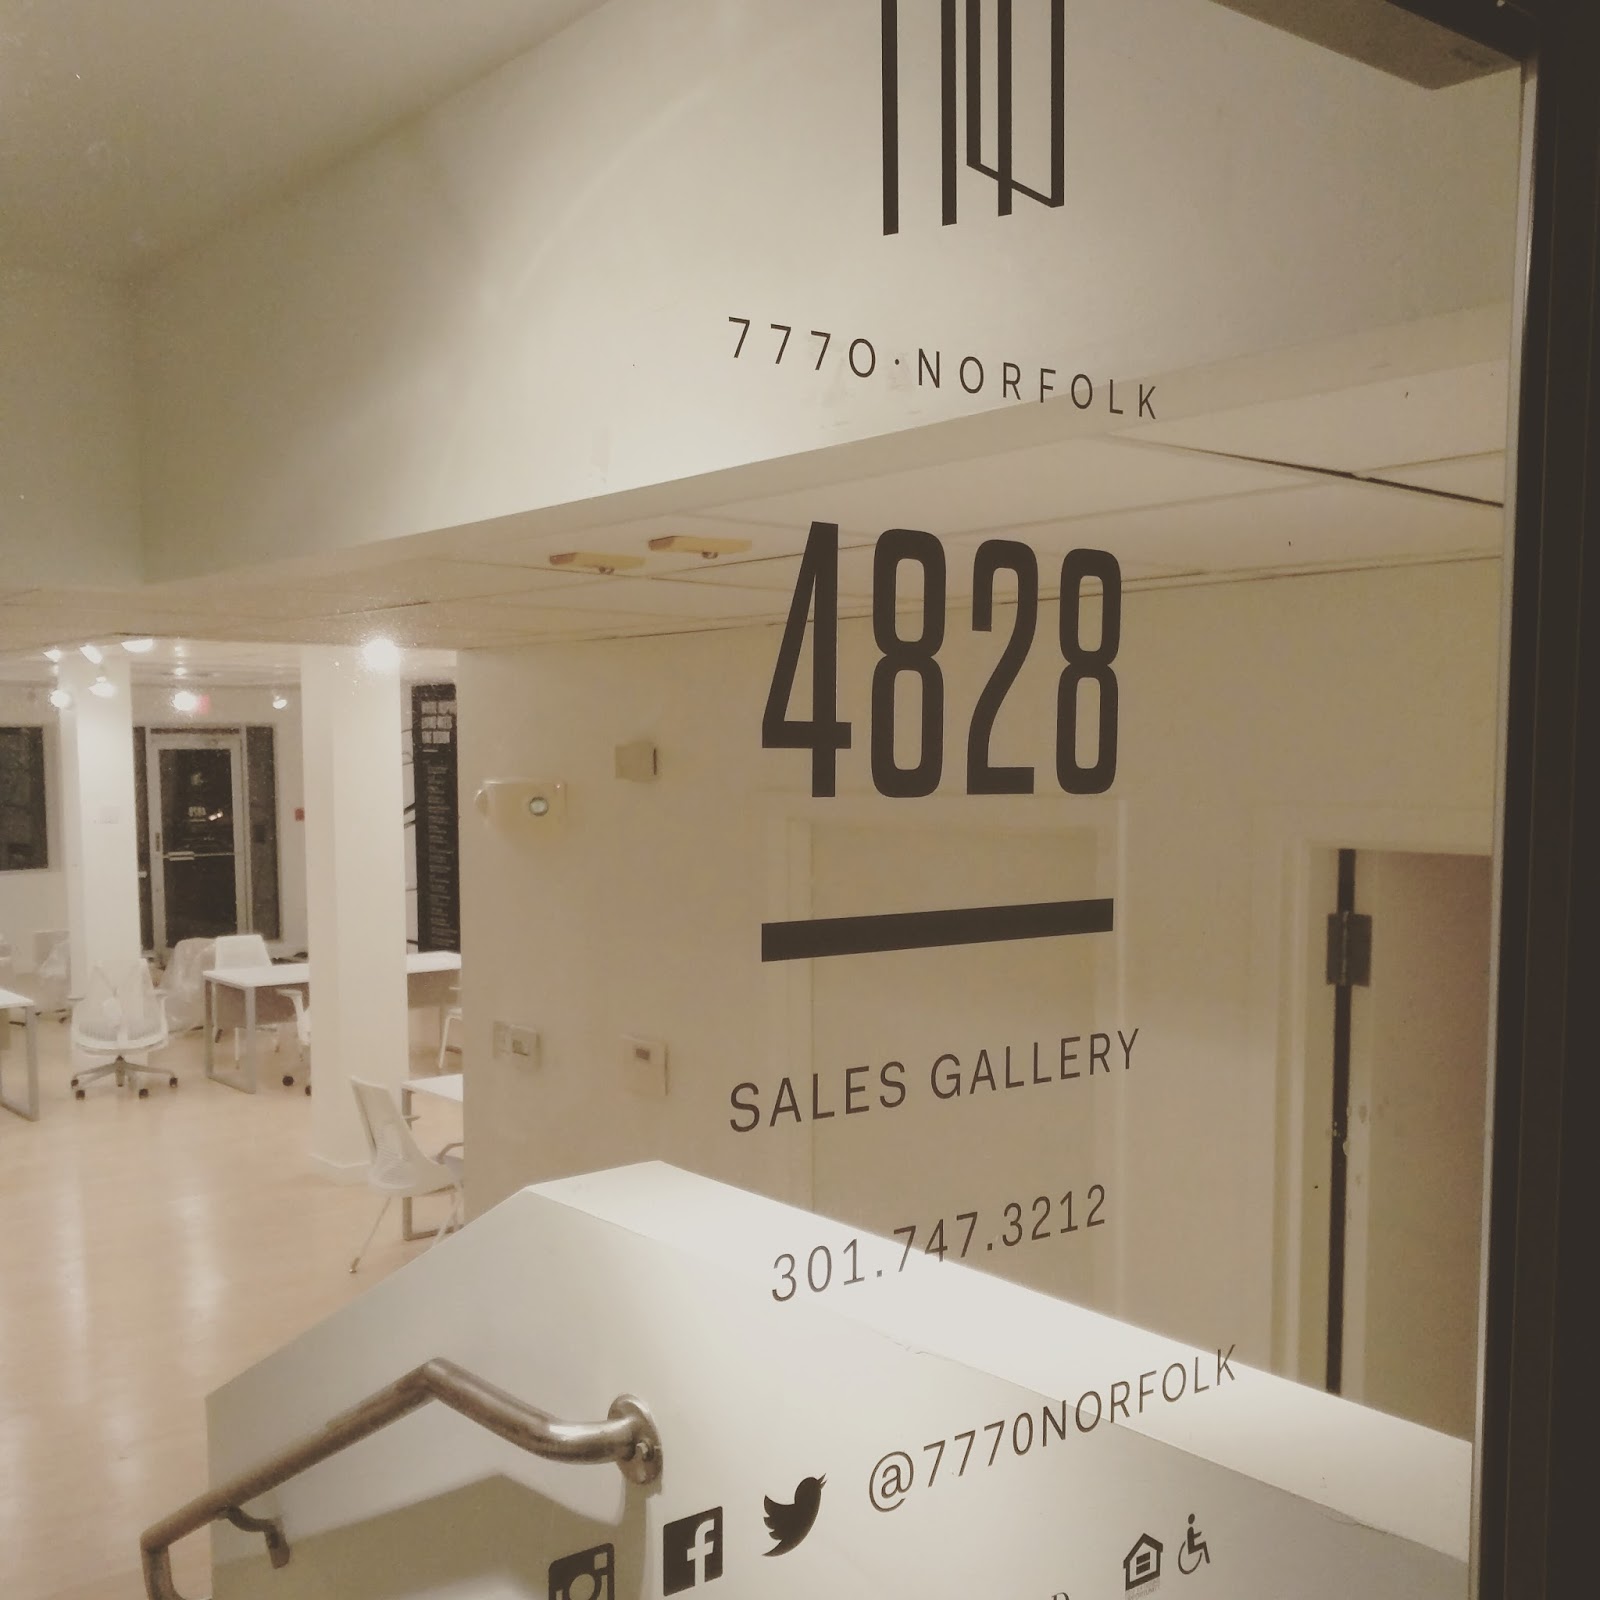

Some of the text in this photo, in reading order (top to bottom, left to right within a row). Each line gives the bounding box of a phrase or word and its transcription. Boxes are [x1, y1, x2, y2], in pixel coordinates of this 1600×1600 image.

[762, 521, 1122, 798] 4828
[729, 1028, 1140, 1133] SALES GALLERY
[771, 1184, 1106, 1303] 301.747.3212
[868, 1343, 1237, 1513] @7770NORFOLK
